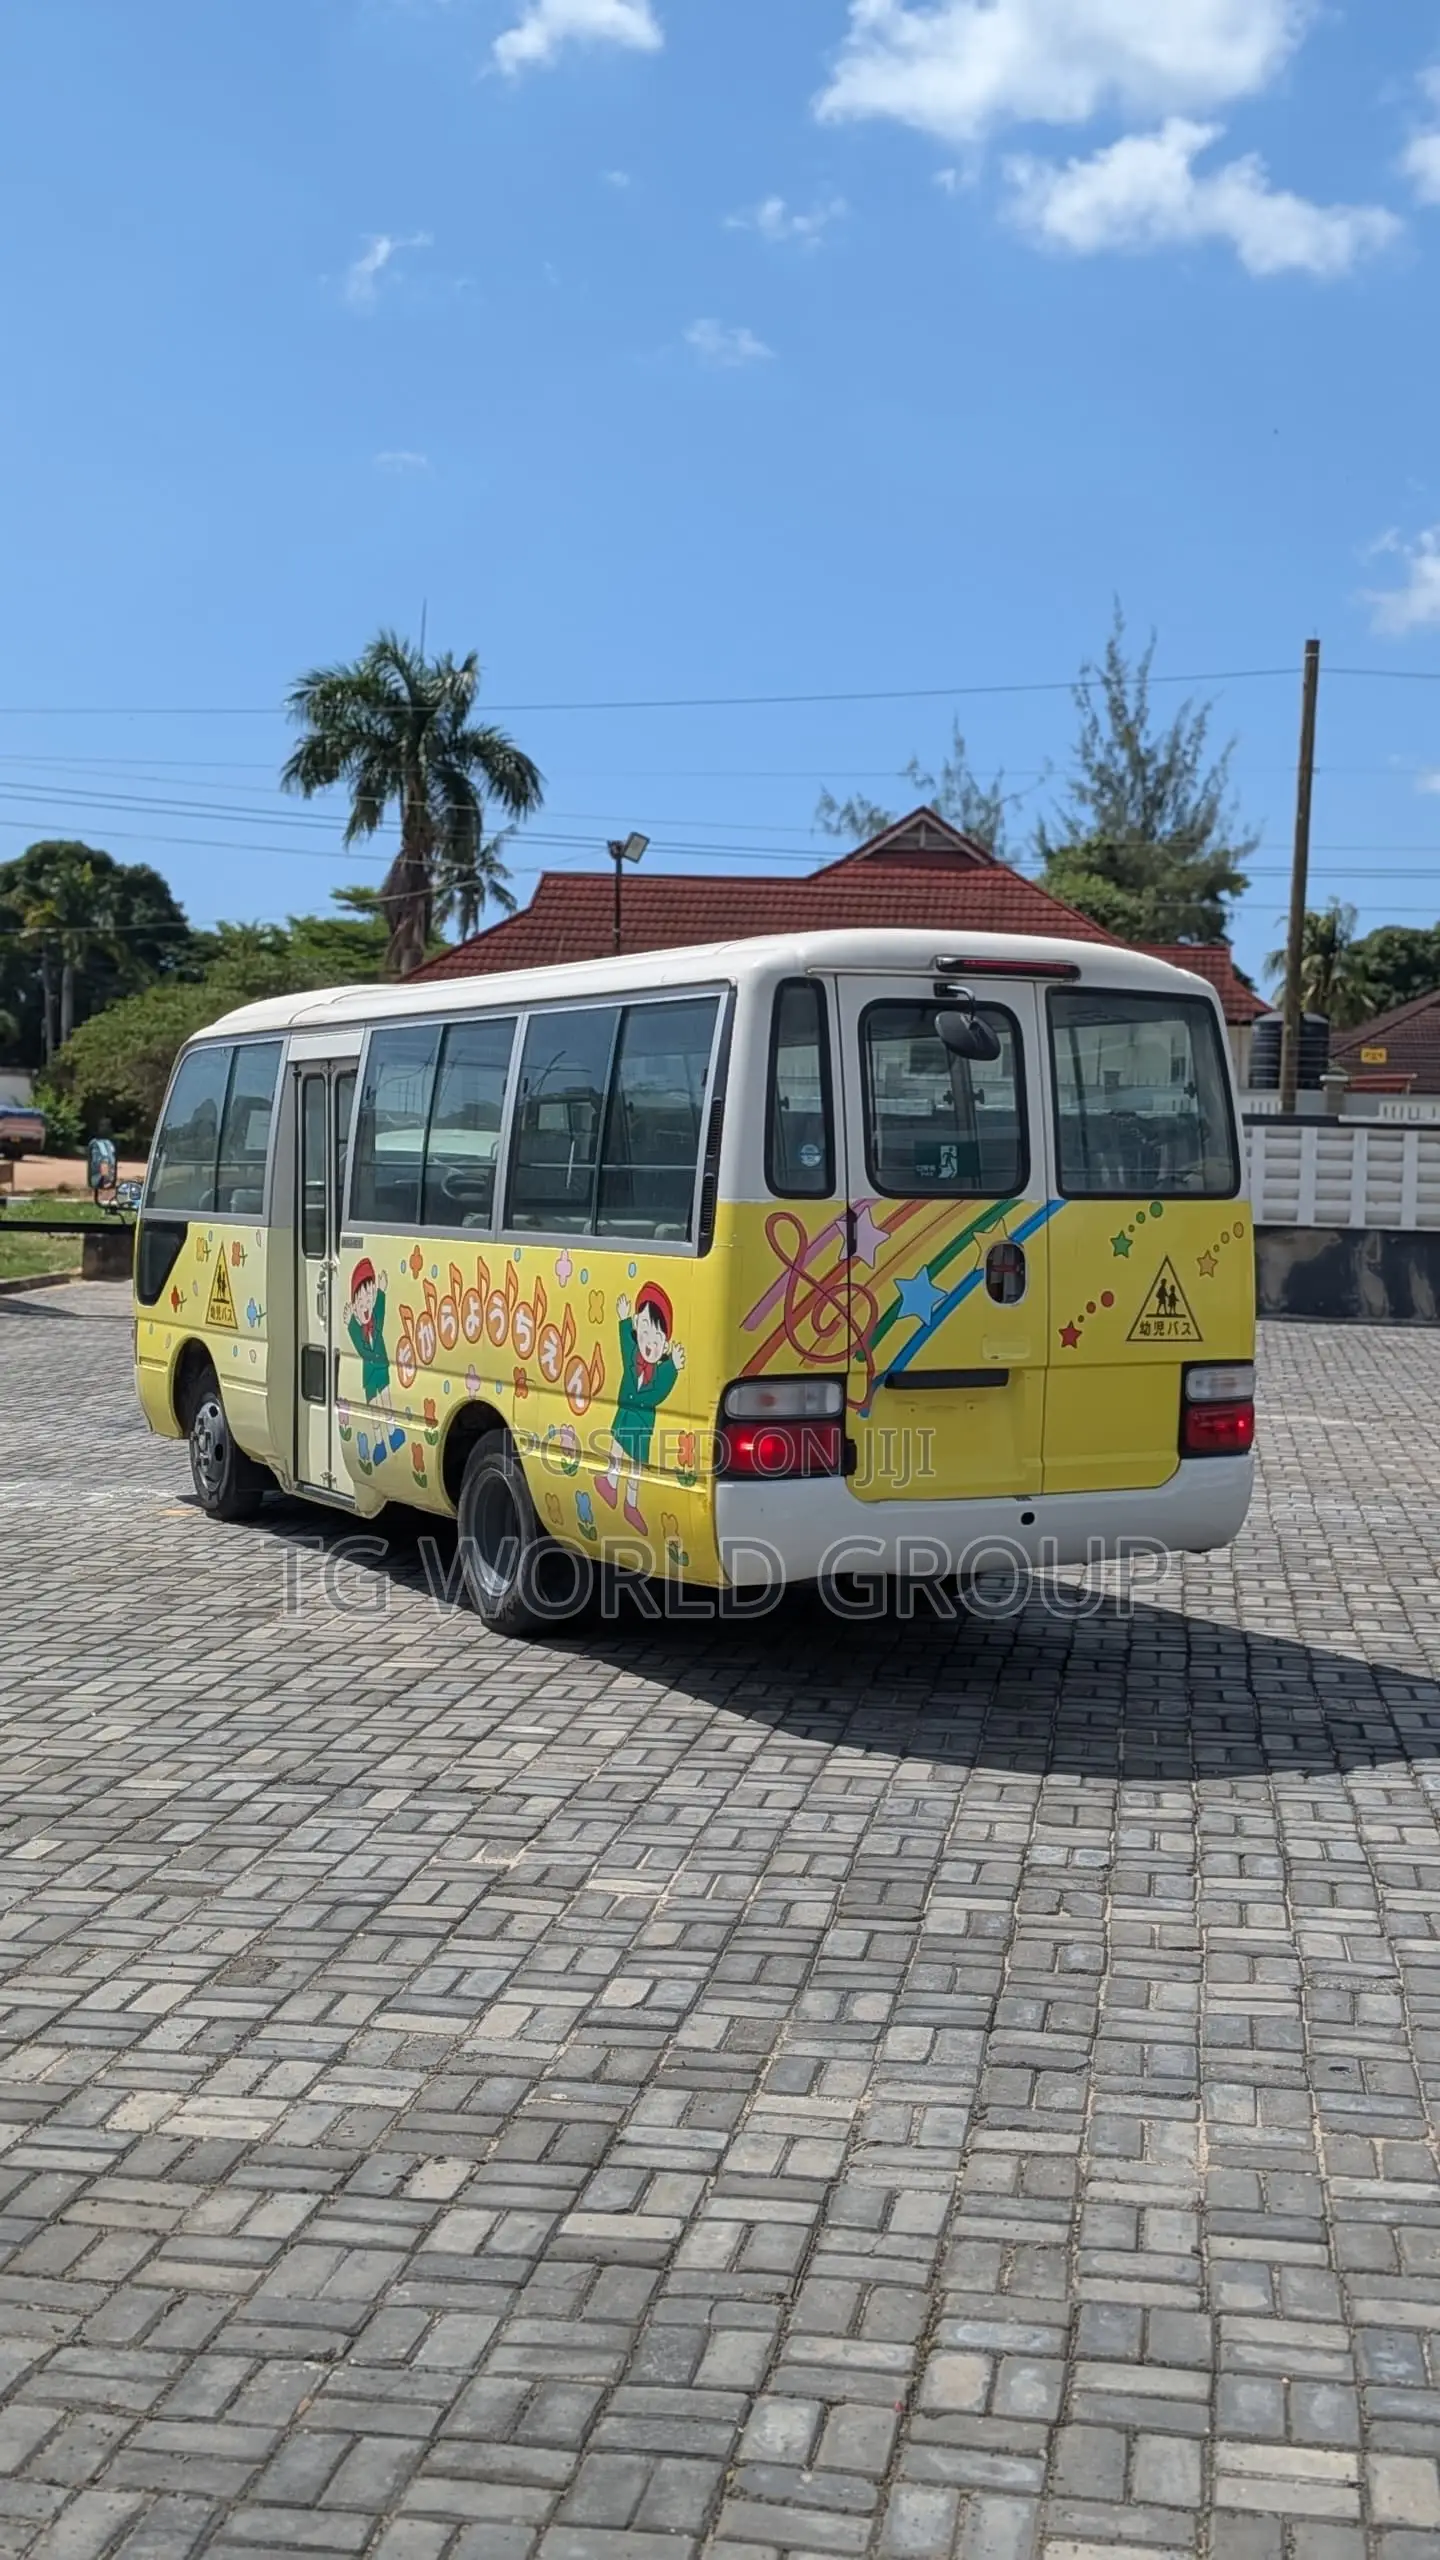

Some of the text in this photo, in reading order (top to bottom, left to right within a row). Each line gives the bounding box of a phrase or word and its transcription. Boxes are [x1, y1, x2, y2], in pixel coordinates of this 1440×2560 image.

[397, 1293, 588, 1410] たからようちえん
[1139, 1320, 1192, 1337] 幼児バス
